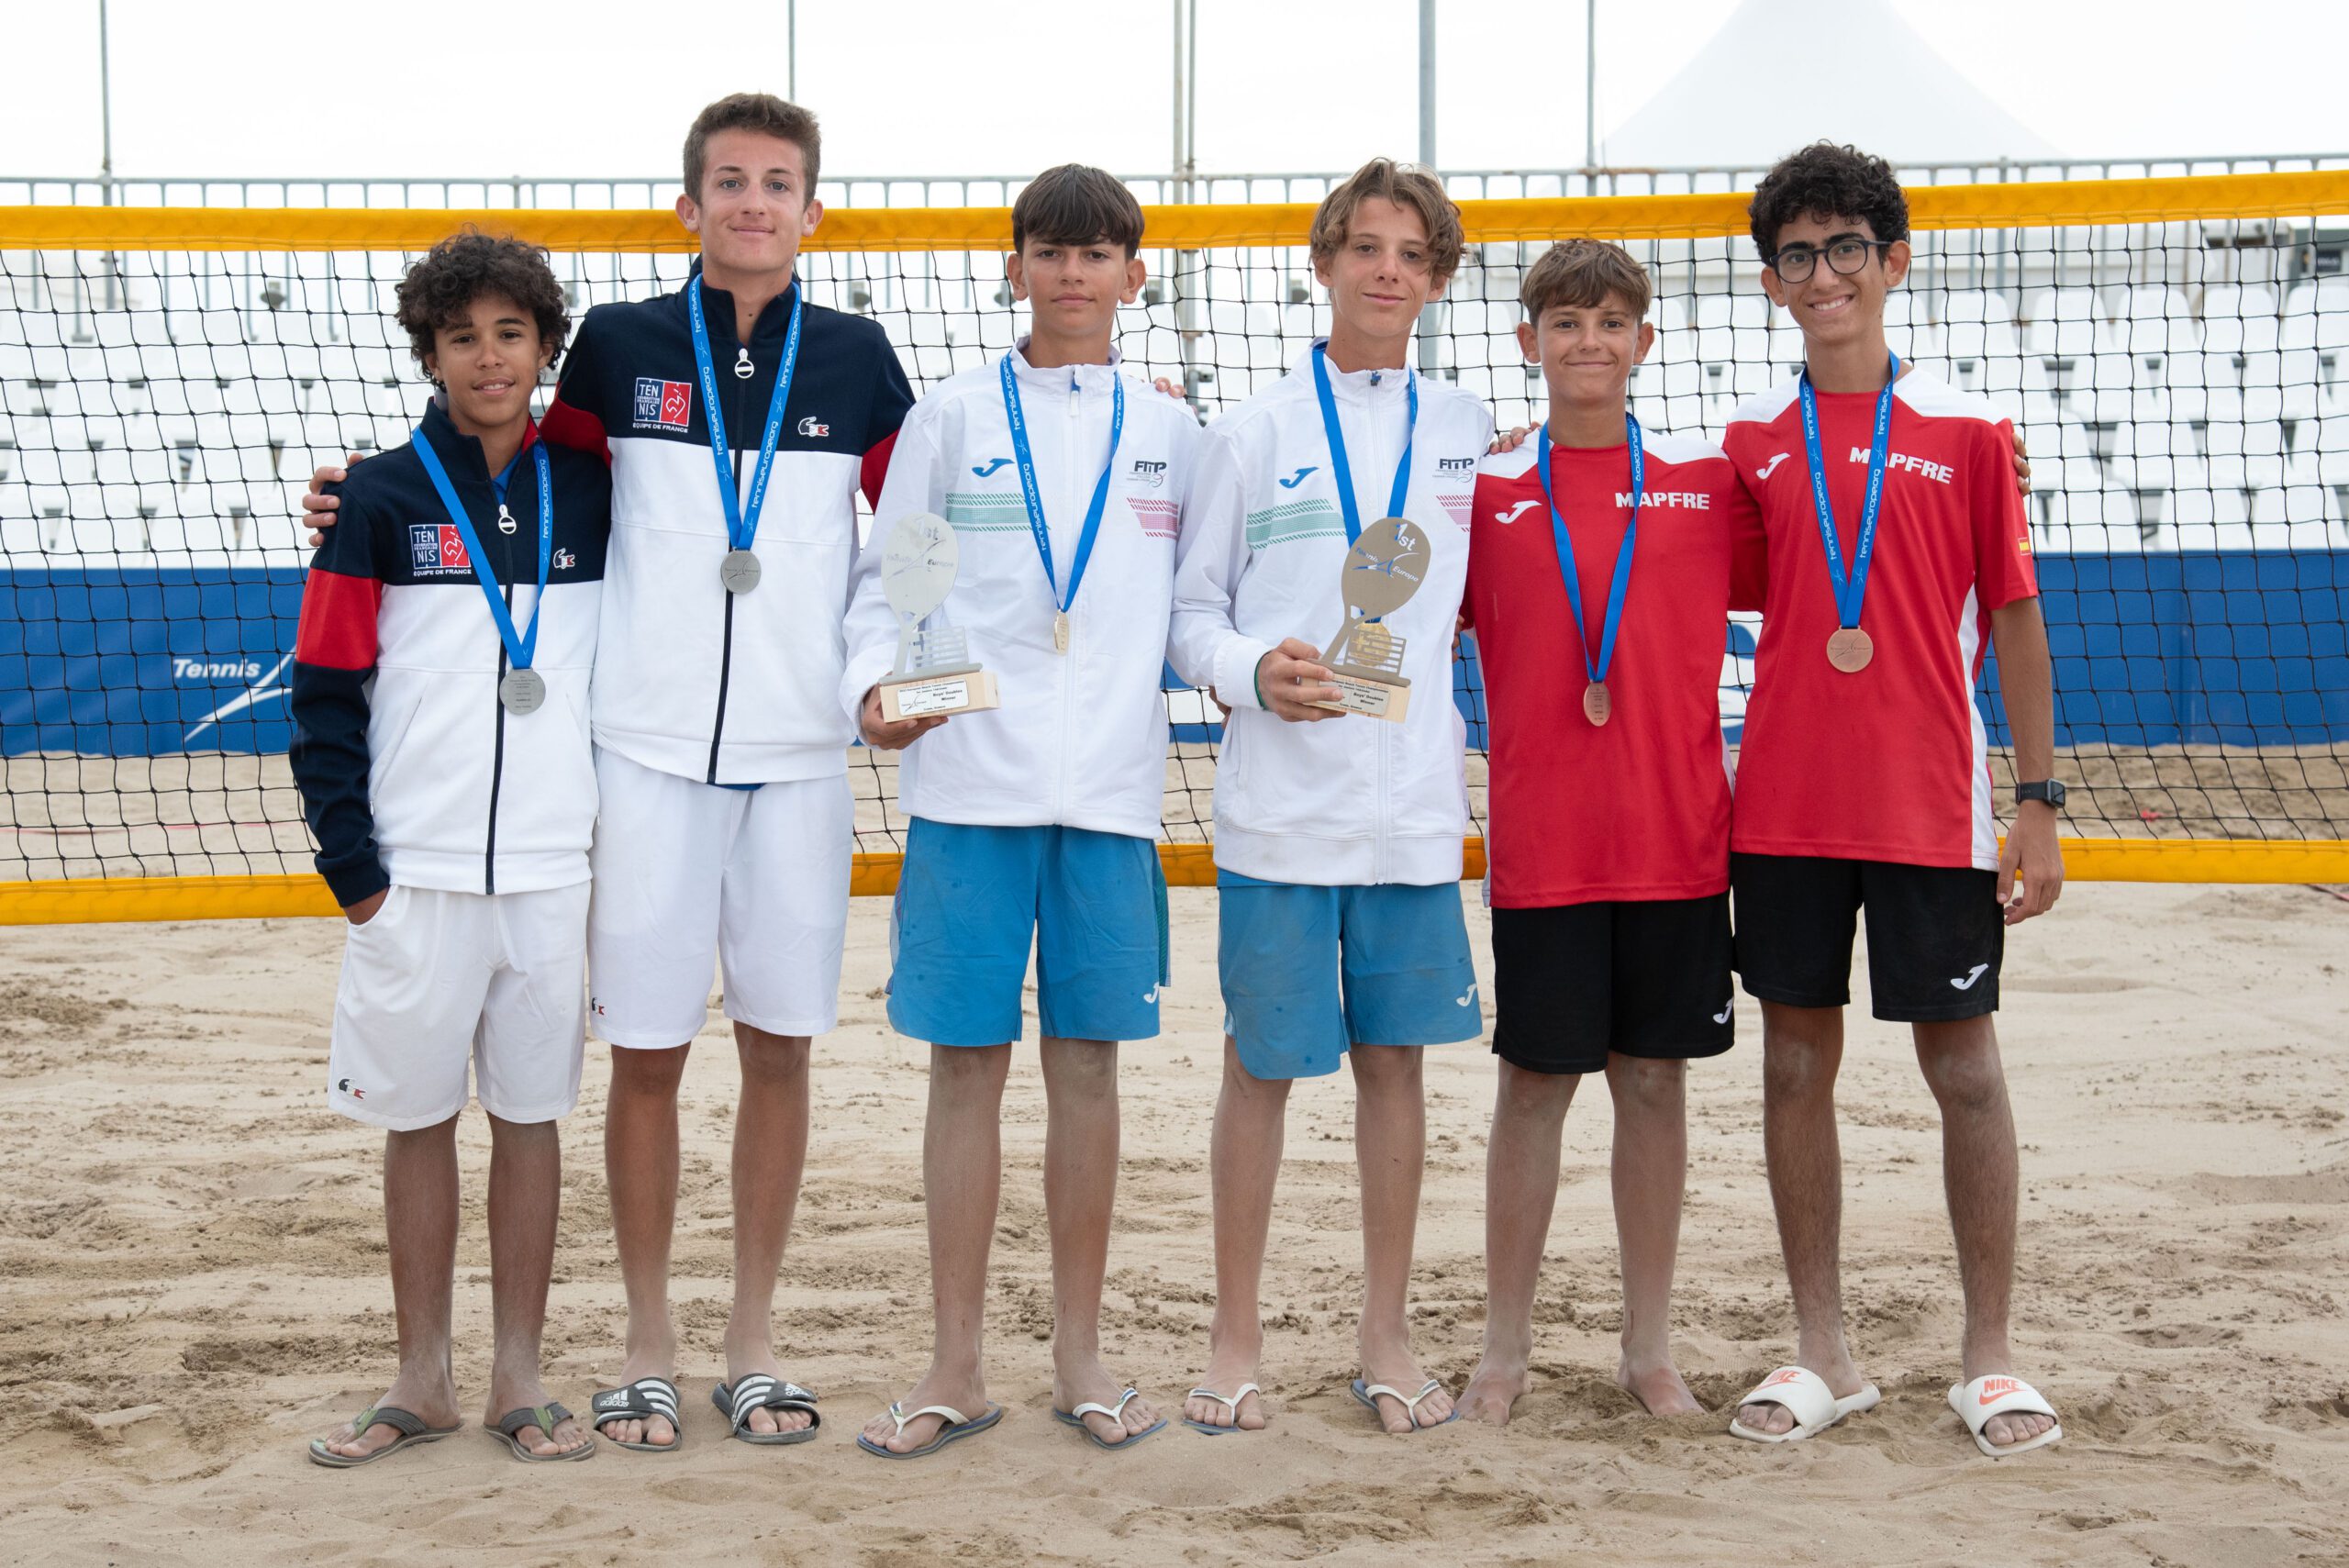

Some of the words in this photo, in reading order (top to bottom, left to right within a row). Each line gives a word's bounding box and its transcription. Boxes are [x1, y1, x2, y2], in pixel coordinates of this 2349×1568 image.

[639, 384, 659, 397] TEN
[639, 403, 657, 416] NIS
[662, 425, 689, 433] FRANCE
[1133, 460, 1167, 473] FITP
[1439, 458, 1475, 470] FITP
[1849, 447, 1954, 484] MPFRE
[1615, 492, 1710, 510] MAPFRE
[414, 530, 435, 543] TEN
[1395, 523, 1417, 550] 1st
[417, 550, 436, 563] NIS
[1393, 565, 1419, 582] Europe
[173, 659, 262, 678] Tennis
[1984, 1379, 2021, 1393] NIKE
